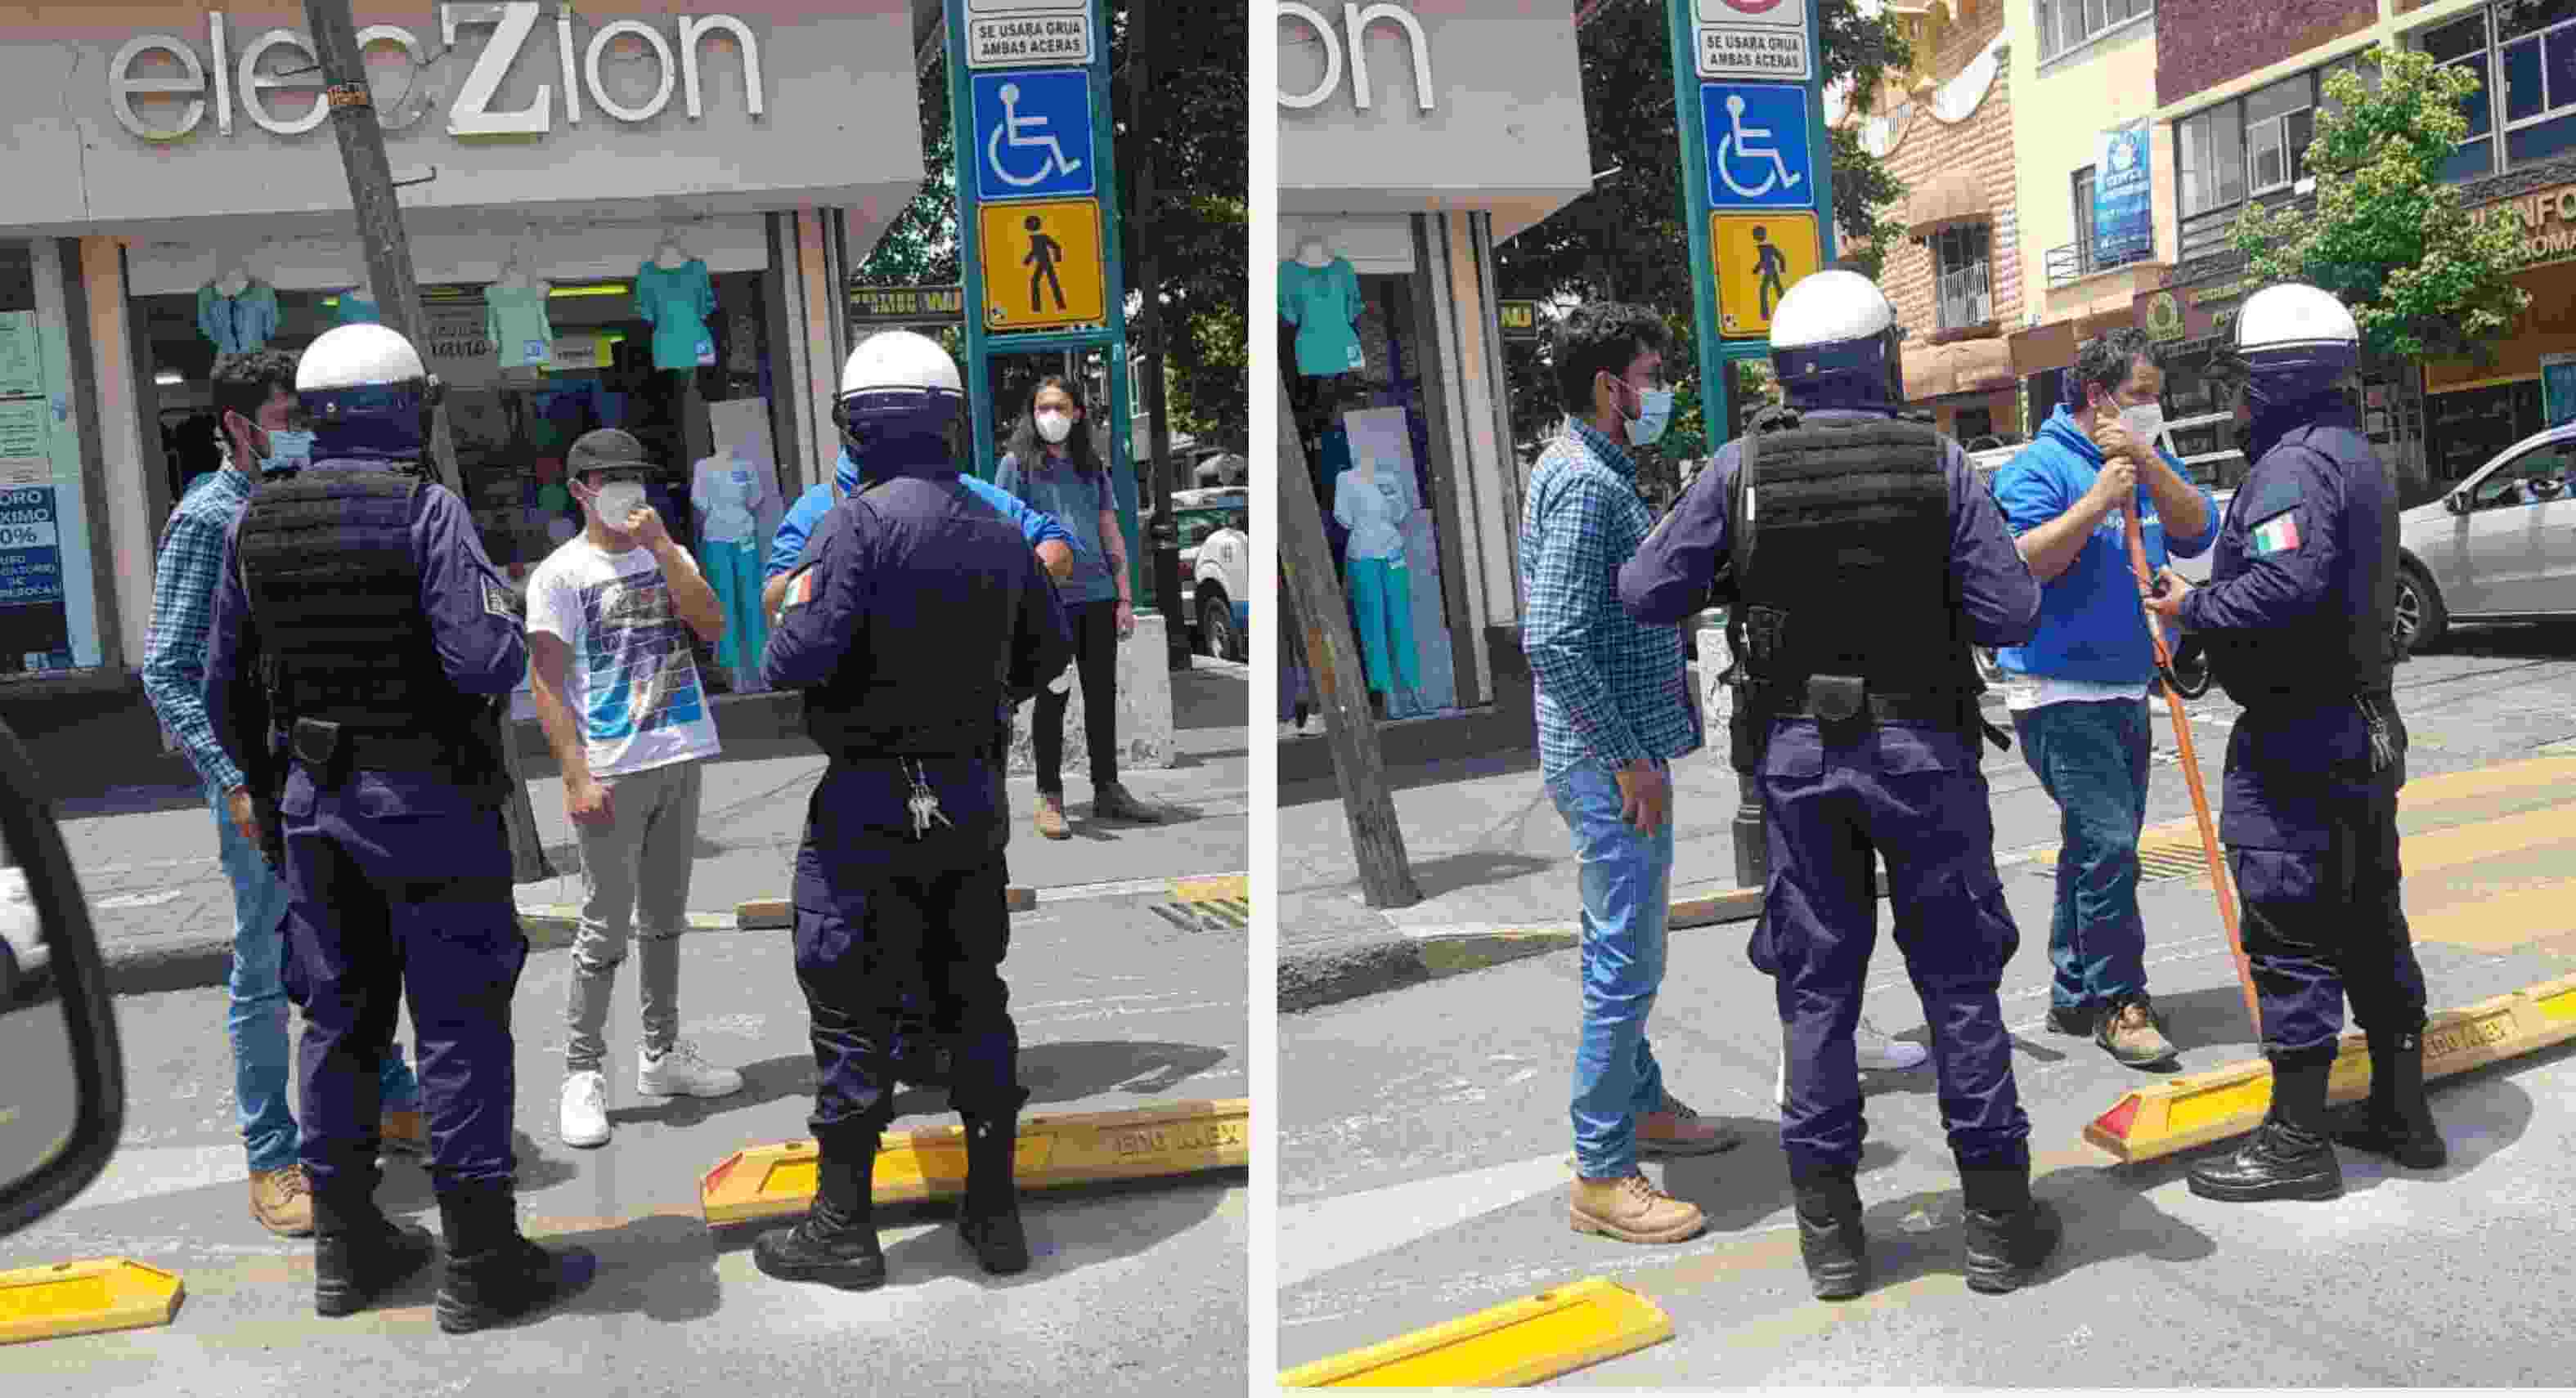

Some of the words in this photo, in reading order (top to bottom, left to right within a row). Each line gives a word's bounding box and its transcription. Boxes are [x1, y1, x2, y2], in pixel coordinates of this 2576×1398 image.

[979, 25, 995, 38] SE
[999, 22, 1042, 38] USARA
[1046, 20, 1080, 35] GRUA
[982, 40, 1026, 55] AMBAS
[1030, 38, 1080, 53] ACERAS
[1707, 35, 1722, 49] SE
[1726, 36, 1766, 50] USARA
[1767, 38, 1799, 51] GRUA
[1710, 52, 1753, 65] AMBAS
[1754, 53, 1798, 68] ACERAS
